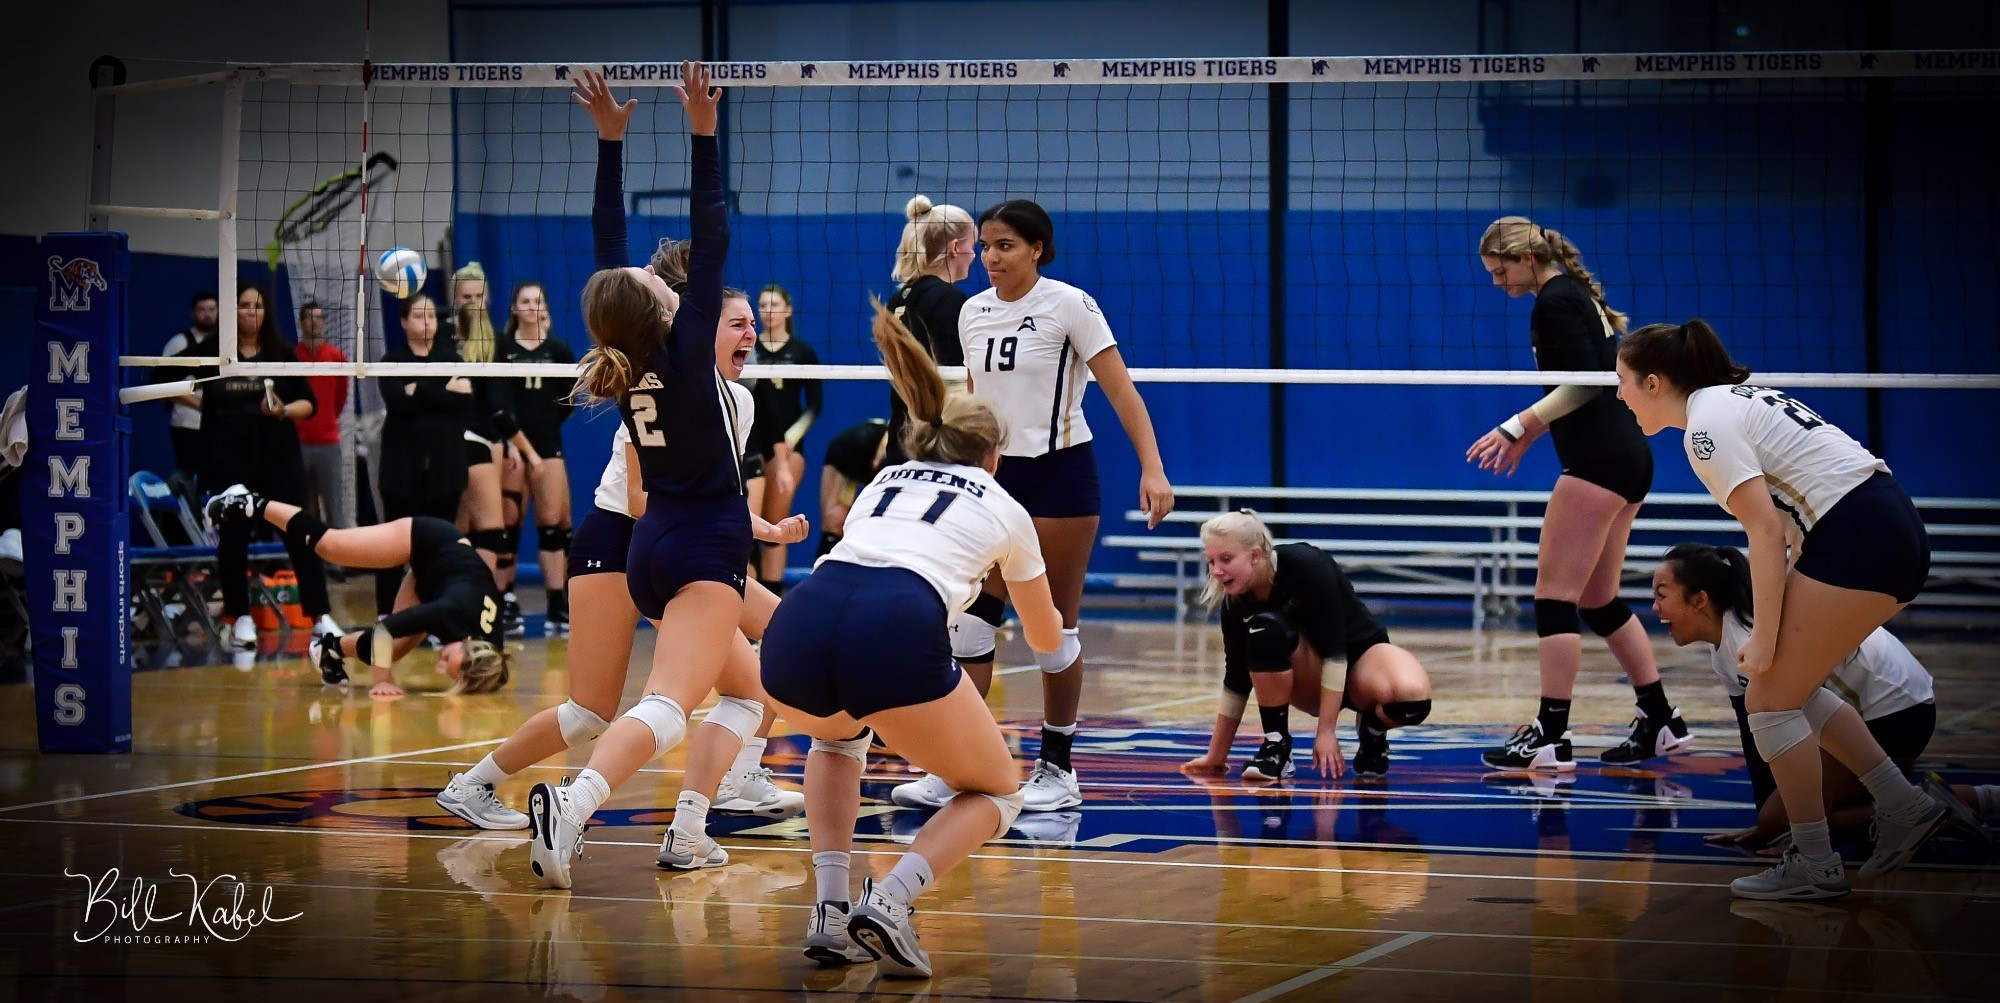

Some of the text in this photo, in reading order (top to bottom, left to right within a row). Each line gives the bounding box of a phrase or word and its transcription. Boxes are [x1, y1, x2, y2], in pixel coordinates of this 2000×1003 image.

[1102, 60, 1277, 77] MEMPHIS TIGERS
[1364, 57, 1545, 75] MEMPHIS TIGERS
[1635, 54, 1822, 72] MEMPHIS TIGERS
[1915, 52, 2000, 69] MEMPH
[455, 65, 523, 81] TIGERS
[700, 63, 767, 80] TIGERS
[848, 62, 1018, 79] MEMPHIS TIGERS
[984, 336, 1018, 373] 19
[630, 394, 667, 447] 2
[870, 486, 961, 526] 11
[48, 341, 91, 726] MEMPHIS
[118, 541, 126, 666] sports imports
[480, 594, 498, 634] 2
